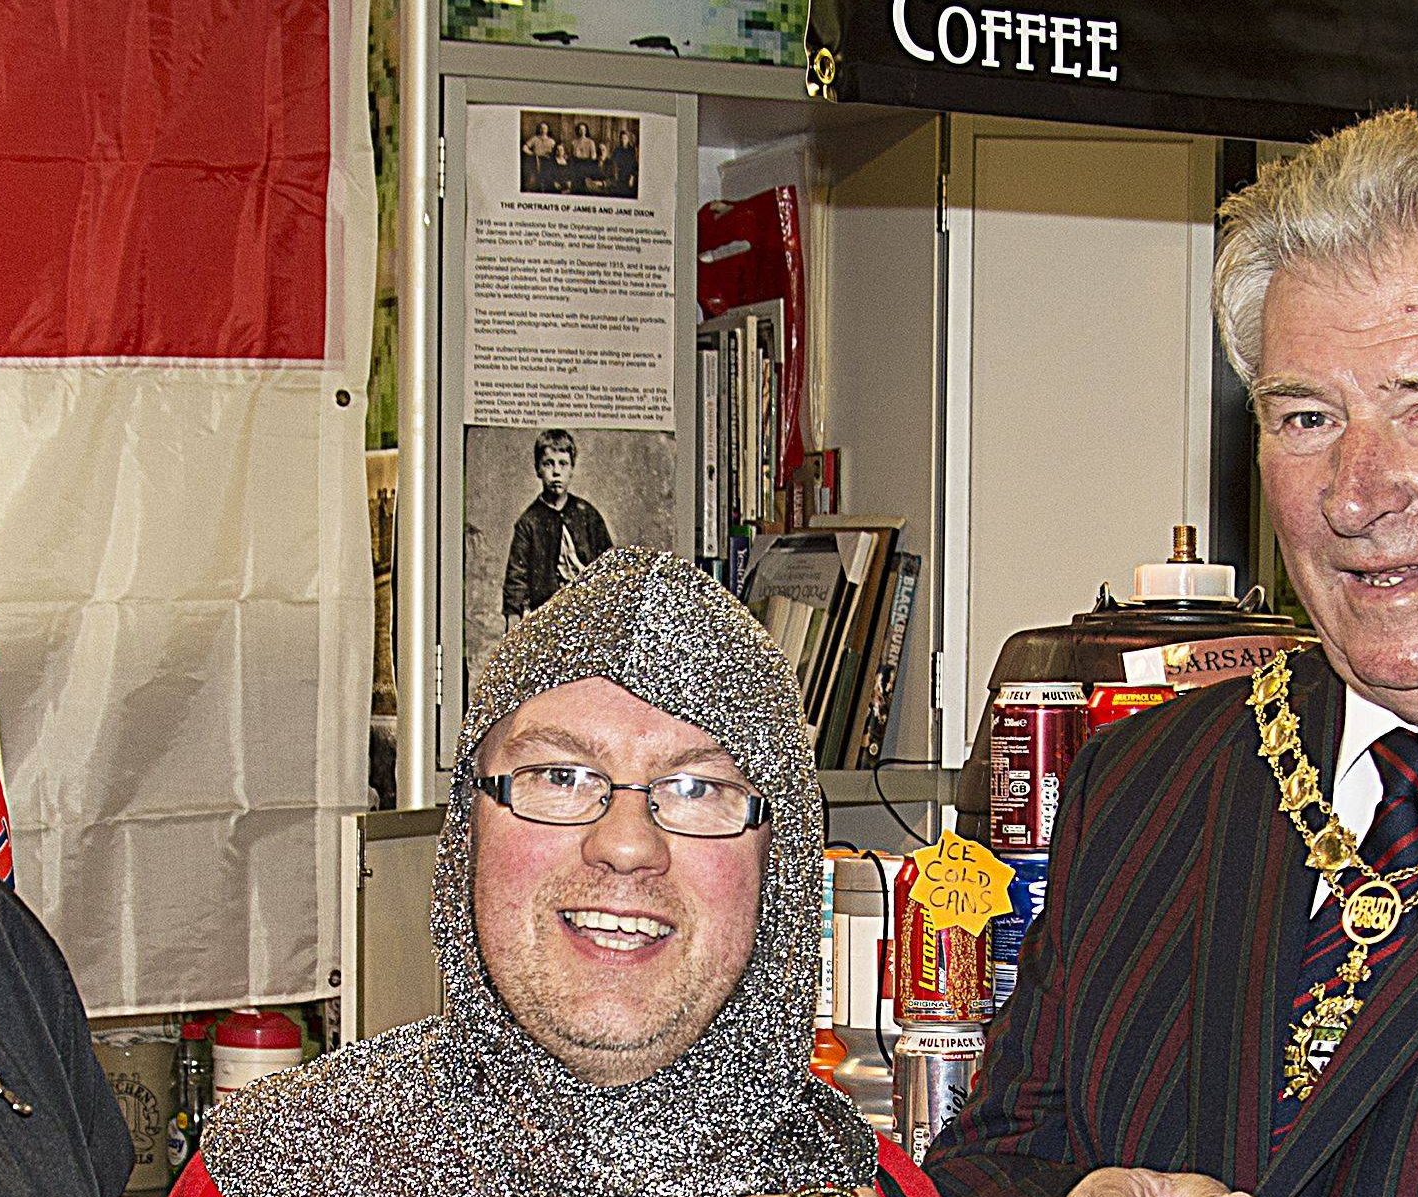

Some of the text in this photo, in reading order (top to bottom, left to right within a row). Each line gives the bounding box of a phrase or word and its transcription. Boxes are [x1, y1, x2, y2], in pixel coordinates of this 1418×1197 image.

[890, 576, 915, 667] BLACKBURN
[938, 839, 976, 863] ICE
[925, 861, 991, 888] COLD
[930, 886, 992, 915] CANS
[908, 1000, 951, 1008] ORIGINAL
[919, 1037, 976, 1048] MULTIPACK
